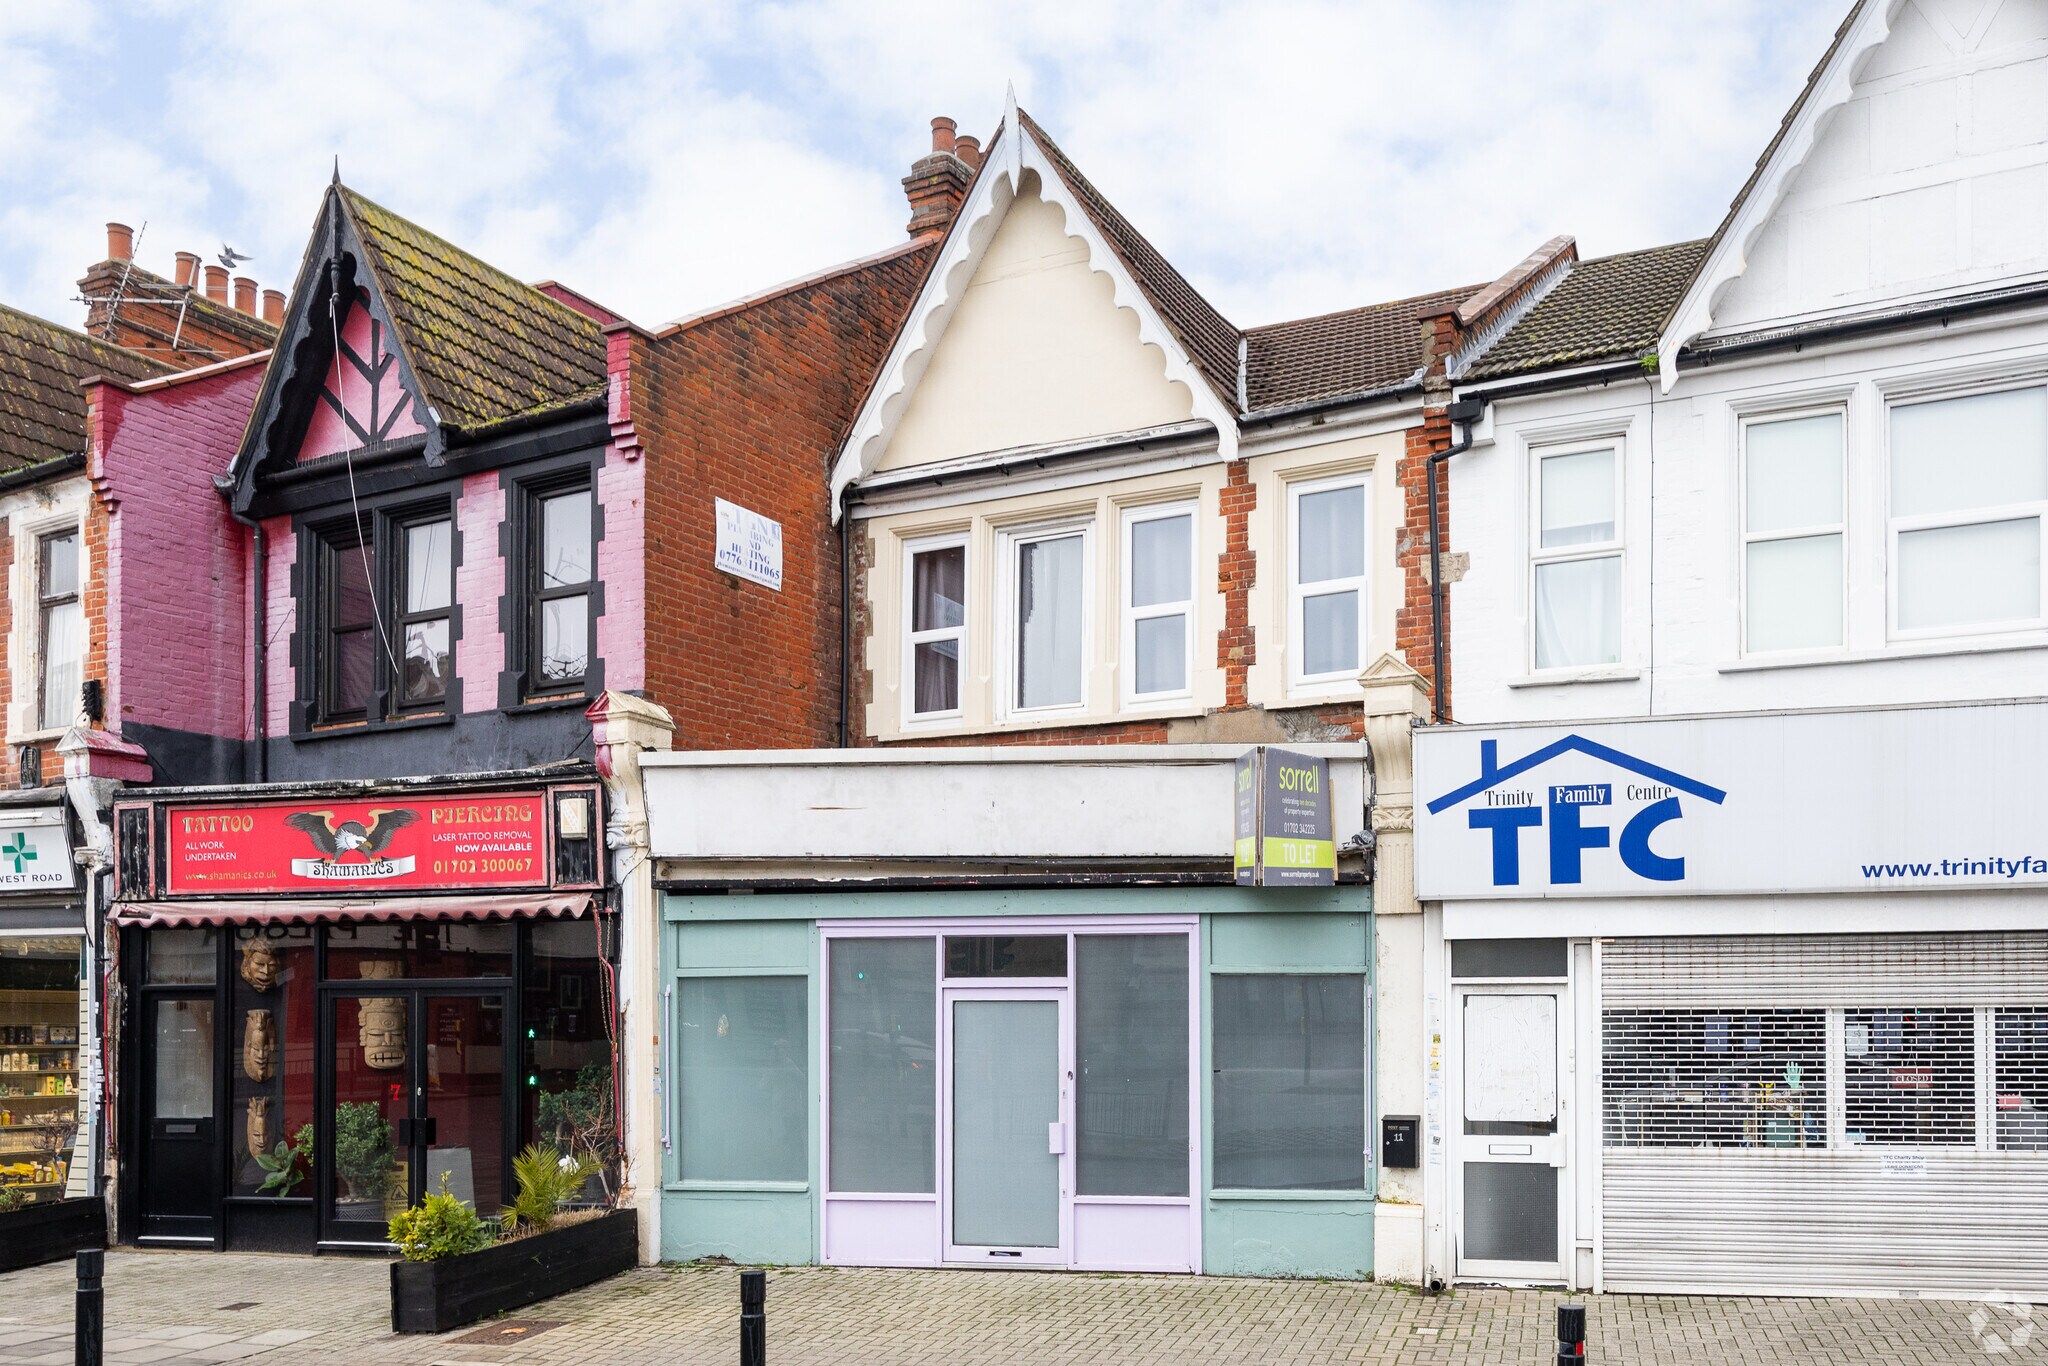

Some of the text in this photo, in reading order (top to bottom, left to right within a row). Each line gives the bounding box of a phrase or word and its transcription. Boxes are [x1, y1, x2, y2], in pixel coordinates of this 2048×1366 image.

[1279, 765, 1319, 793] sorrell
[1485, 784, 1672, 807] Trinity Family Centre
[431, 804, 532, 824] PIERCING
[182, 815, 254, 833] TATTOO
[433, 831, 532, 842] LASER TATTOO REMOVAL
[1468, 784, 1685, 885] TFC
[185, 841, 224, 850] ALL WORK
[455, 843, 532, 853] NOW AVAILABLE
[185, 852, 237, 861] UNDERTAKEN
[1282, 843, 1317, 865] TO LET
[433, 858, 532, 874] 01702 300067
[1861, 855, 2048, 878] www.trinityfa
[32, 874, 62, 882] ROAD
[185, 869, 277, 881] www.shamanics.co.uk
[390, 1084, 400, 1101] 7
[1393, 1133, 1404, 1142] 11
